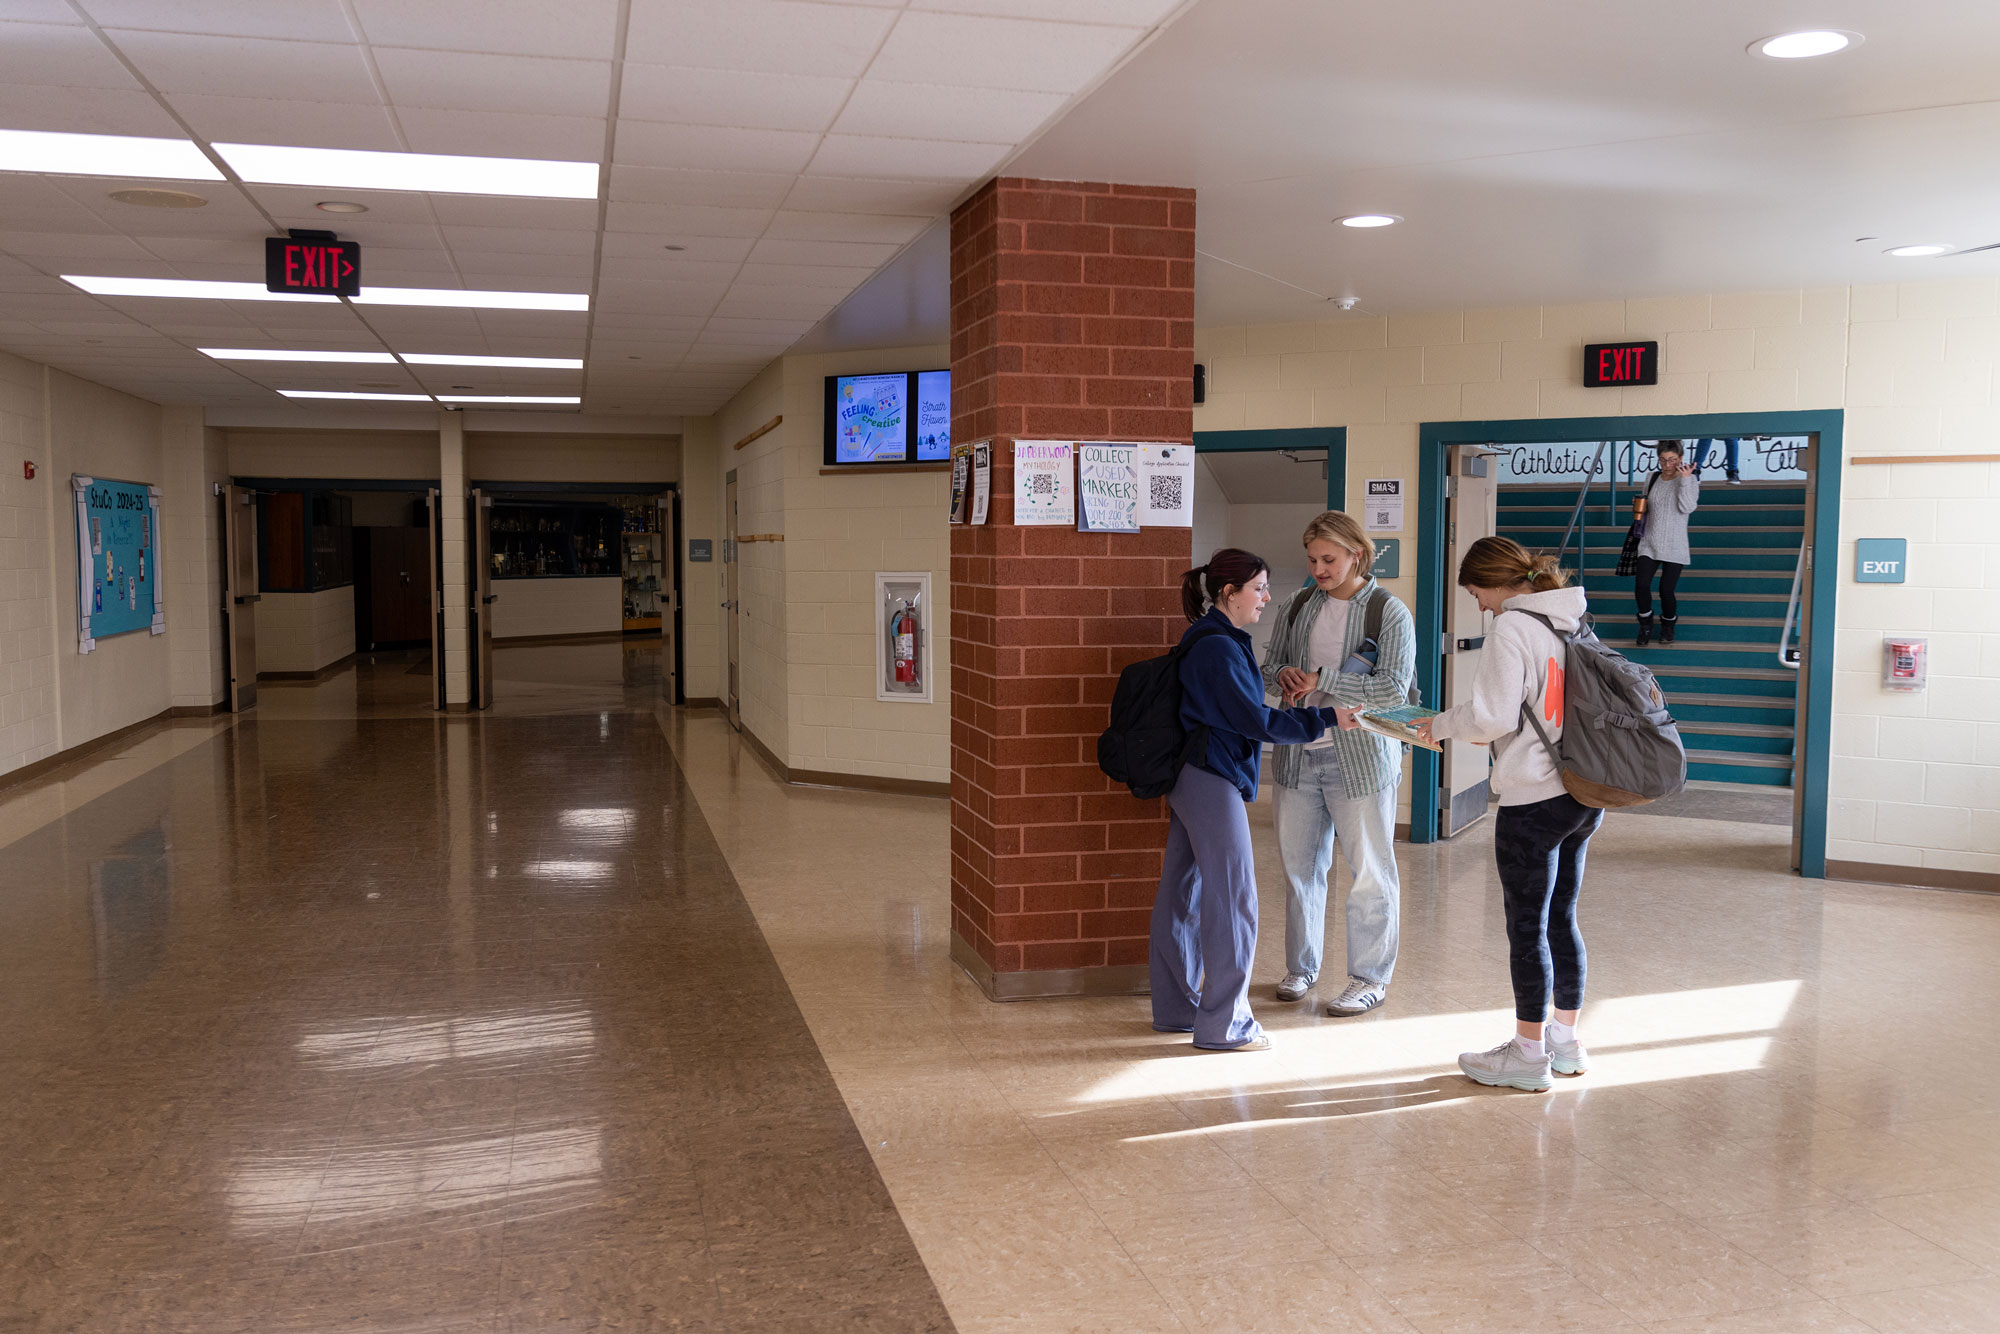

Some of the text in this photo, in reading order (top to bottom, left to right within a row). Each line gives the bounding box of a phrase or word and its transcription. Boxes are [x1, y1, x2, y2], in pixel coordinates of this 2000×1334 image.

[285, 245, 344, 289] EXIT
[1599, 347, 1646, 381] EXIT
[841, 404, 875, 421] FEELING
[922, 400, 947, 413] Strath
[862, 416, 901, 428] creative
[921, 414, 947, 427] Haven
[1085, 447, 1132, 464] COLLECT
[1511, 446, 1604, 475] Athletics
[1023, 461, 1061, 470] MYTHOLOGY
[1096, 465, 1126, 480] USED
[1082, 478, 1138, 500] MARKERS
[91, 487, 144, 511] StuCo 2024-25
[1113, 499, 1125, 511] TO
[1108, 510, 1122, 521] 200
[1863, 561, 1900, 574] EXIT
